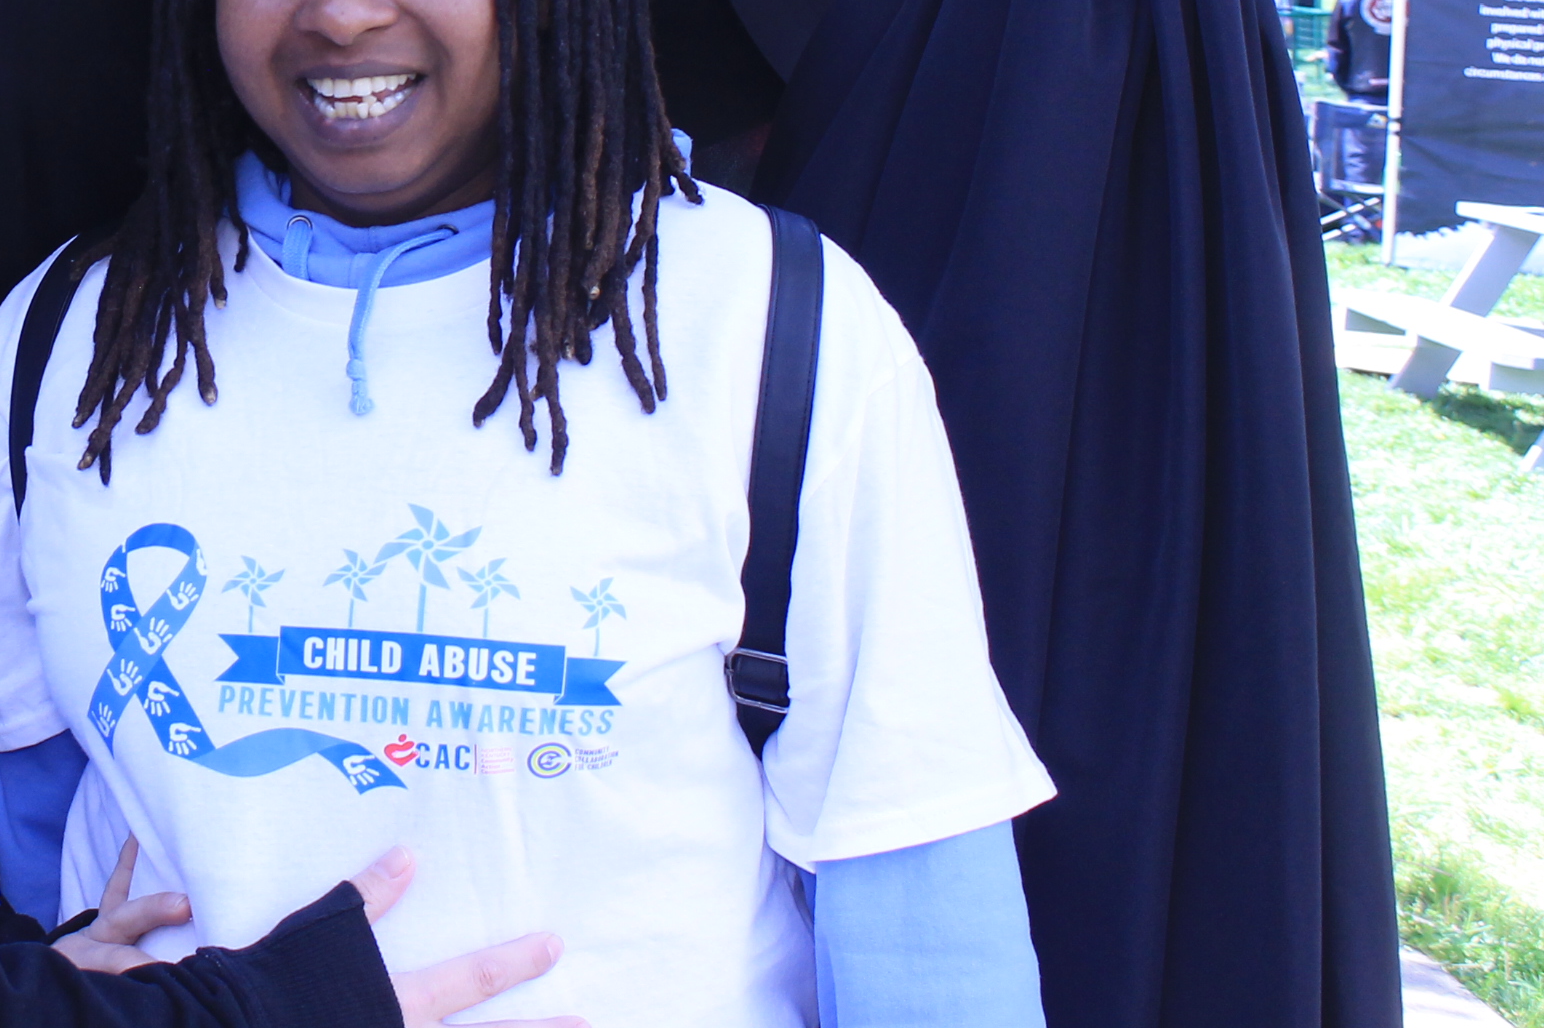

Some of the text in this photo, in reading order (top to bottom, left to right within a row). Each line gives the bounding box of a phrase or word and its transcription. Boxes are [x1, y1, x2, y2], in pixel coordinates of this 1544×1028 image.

[303, 636, 537, 685] CHILD ABUSE
[218, 685, 614, 736] PREVENTION AWARENESS
[415, 742, 471, 771] CAC
